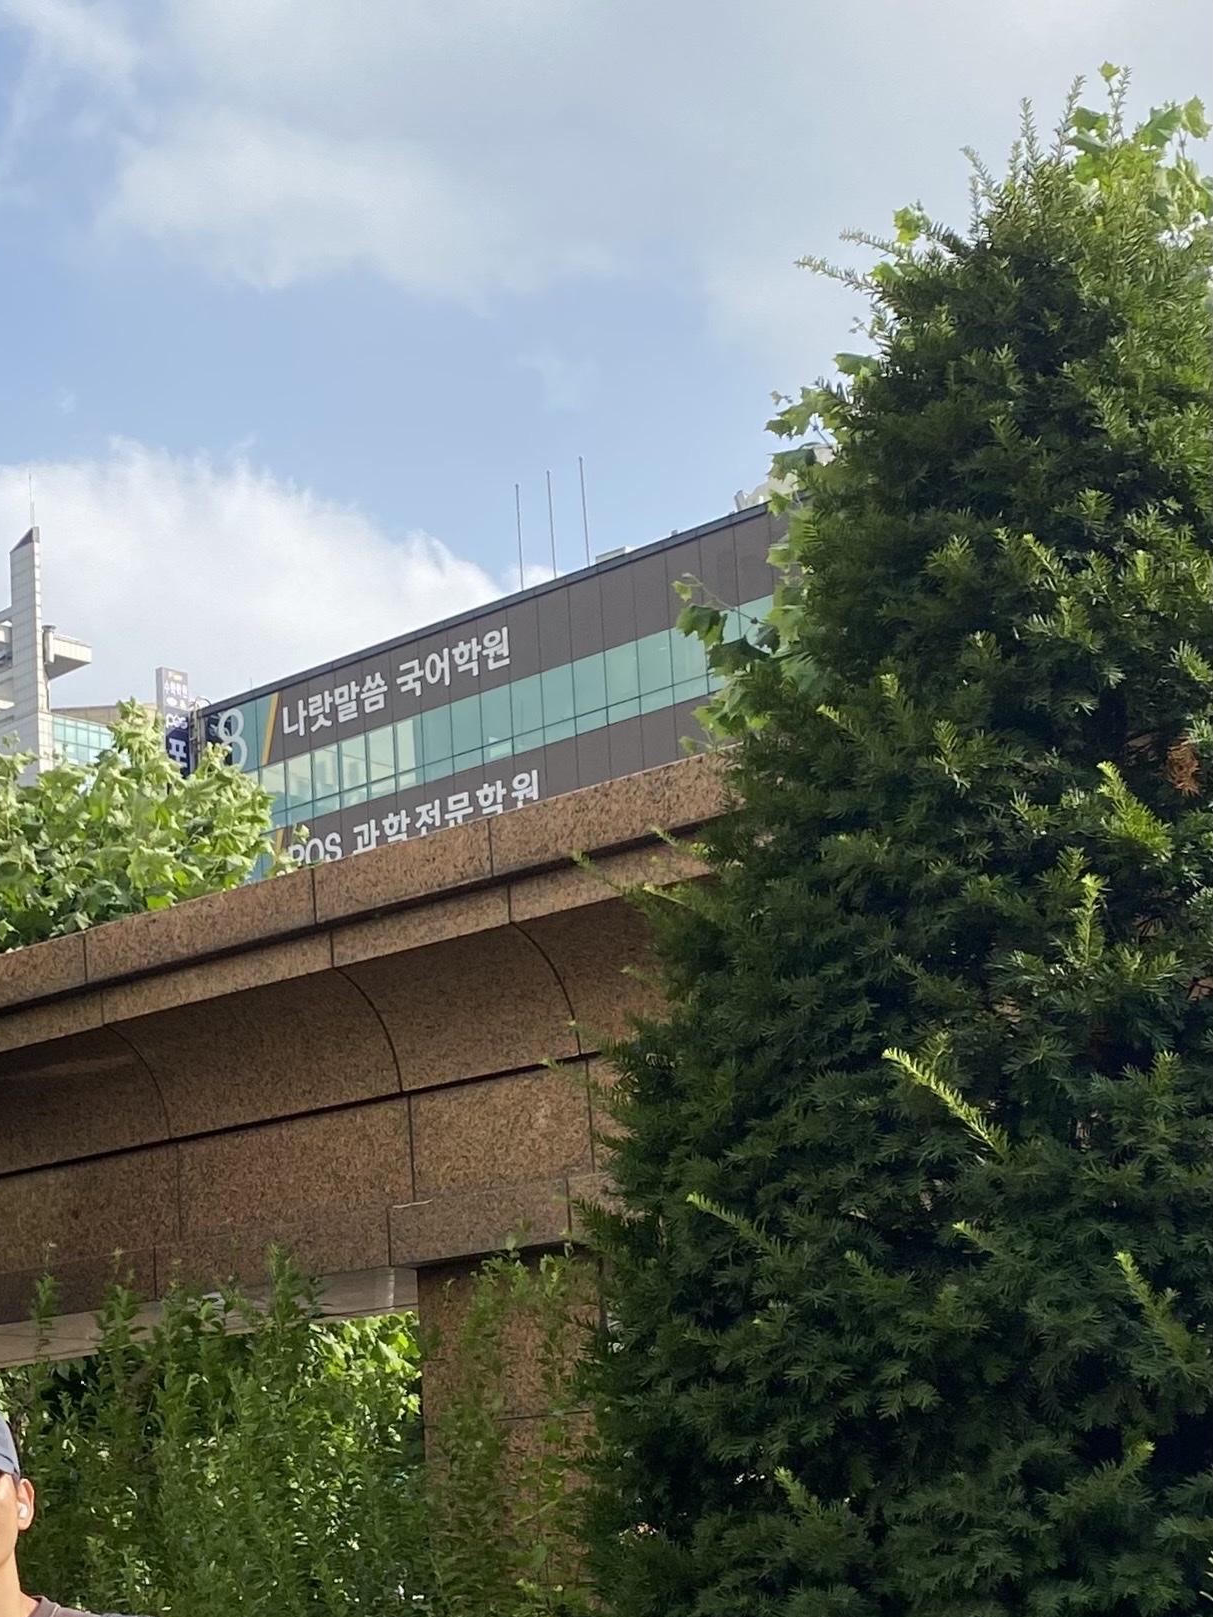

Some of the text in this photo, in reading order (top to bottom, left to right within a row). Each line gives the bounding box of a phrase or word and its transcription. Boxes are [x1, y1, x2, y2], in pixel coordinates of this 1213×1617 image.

[282, 672, 388, 736] 나랏말씀
[396, 627, 510, 697] 국어학원
[352, 769, 539, 855] 과학전문학원
